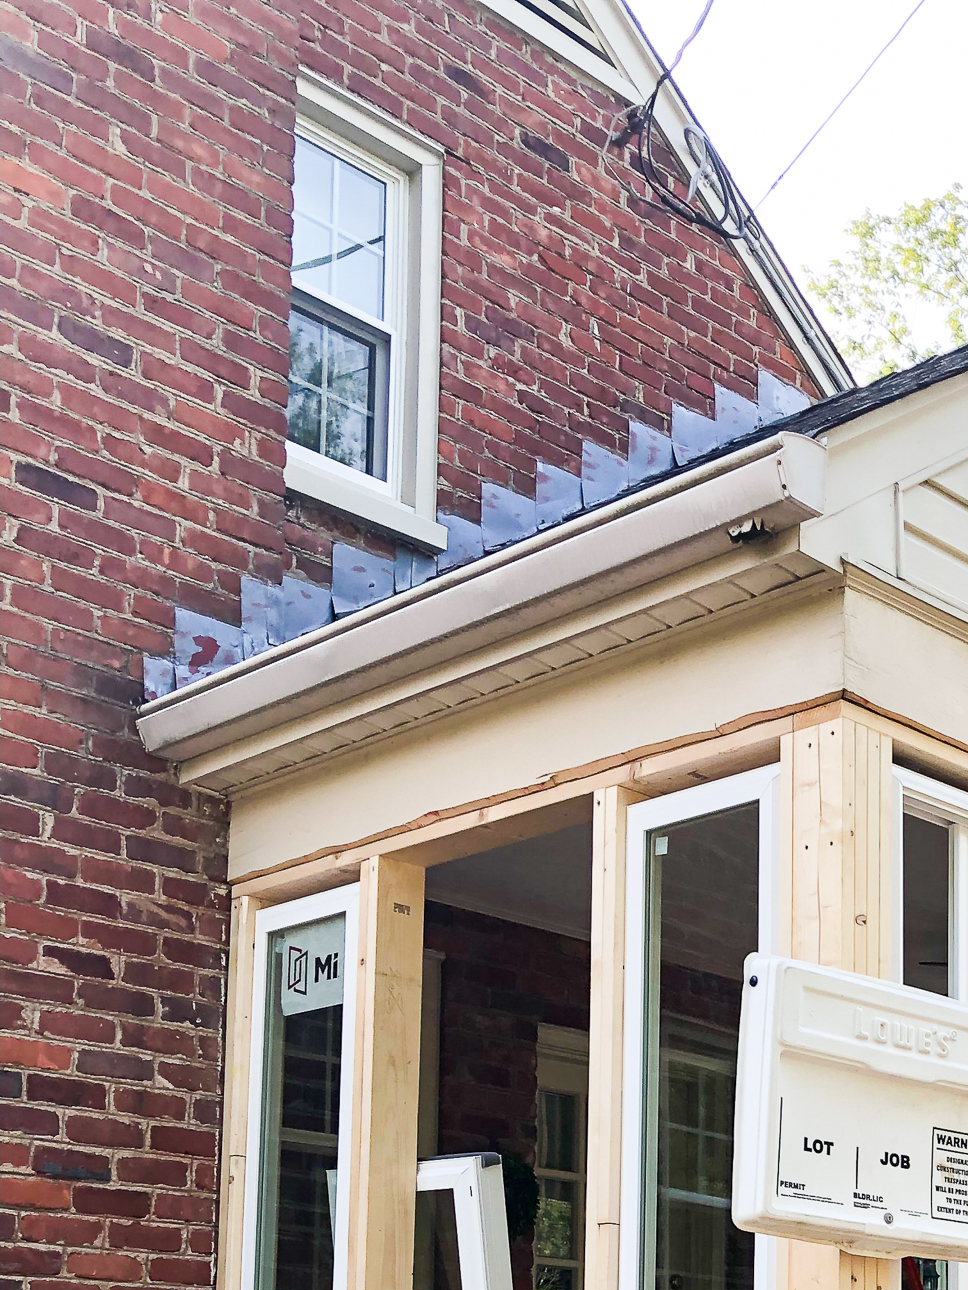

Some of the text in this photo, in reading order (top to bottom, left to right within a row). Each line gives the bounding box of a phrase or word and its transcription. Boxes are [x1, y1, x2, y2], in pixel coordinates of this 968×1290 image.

[314, 952, 339, 983] Mi
[854, 1006, 951, 1058] LOWE'S
[803, 1136, 834, 1156] LOT
[880, 1151, 911, 1170] JOB
[780, 1180, 806, 1191] PERMIT
[935, 1185, 947, 1194] WILL
[947, 1187, 954, 1195] BE
[937, 1205, 954, 1215] EXTENT
